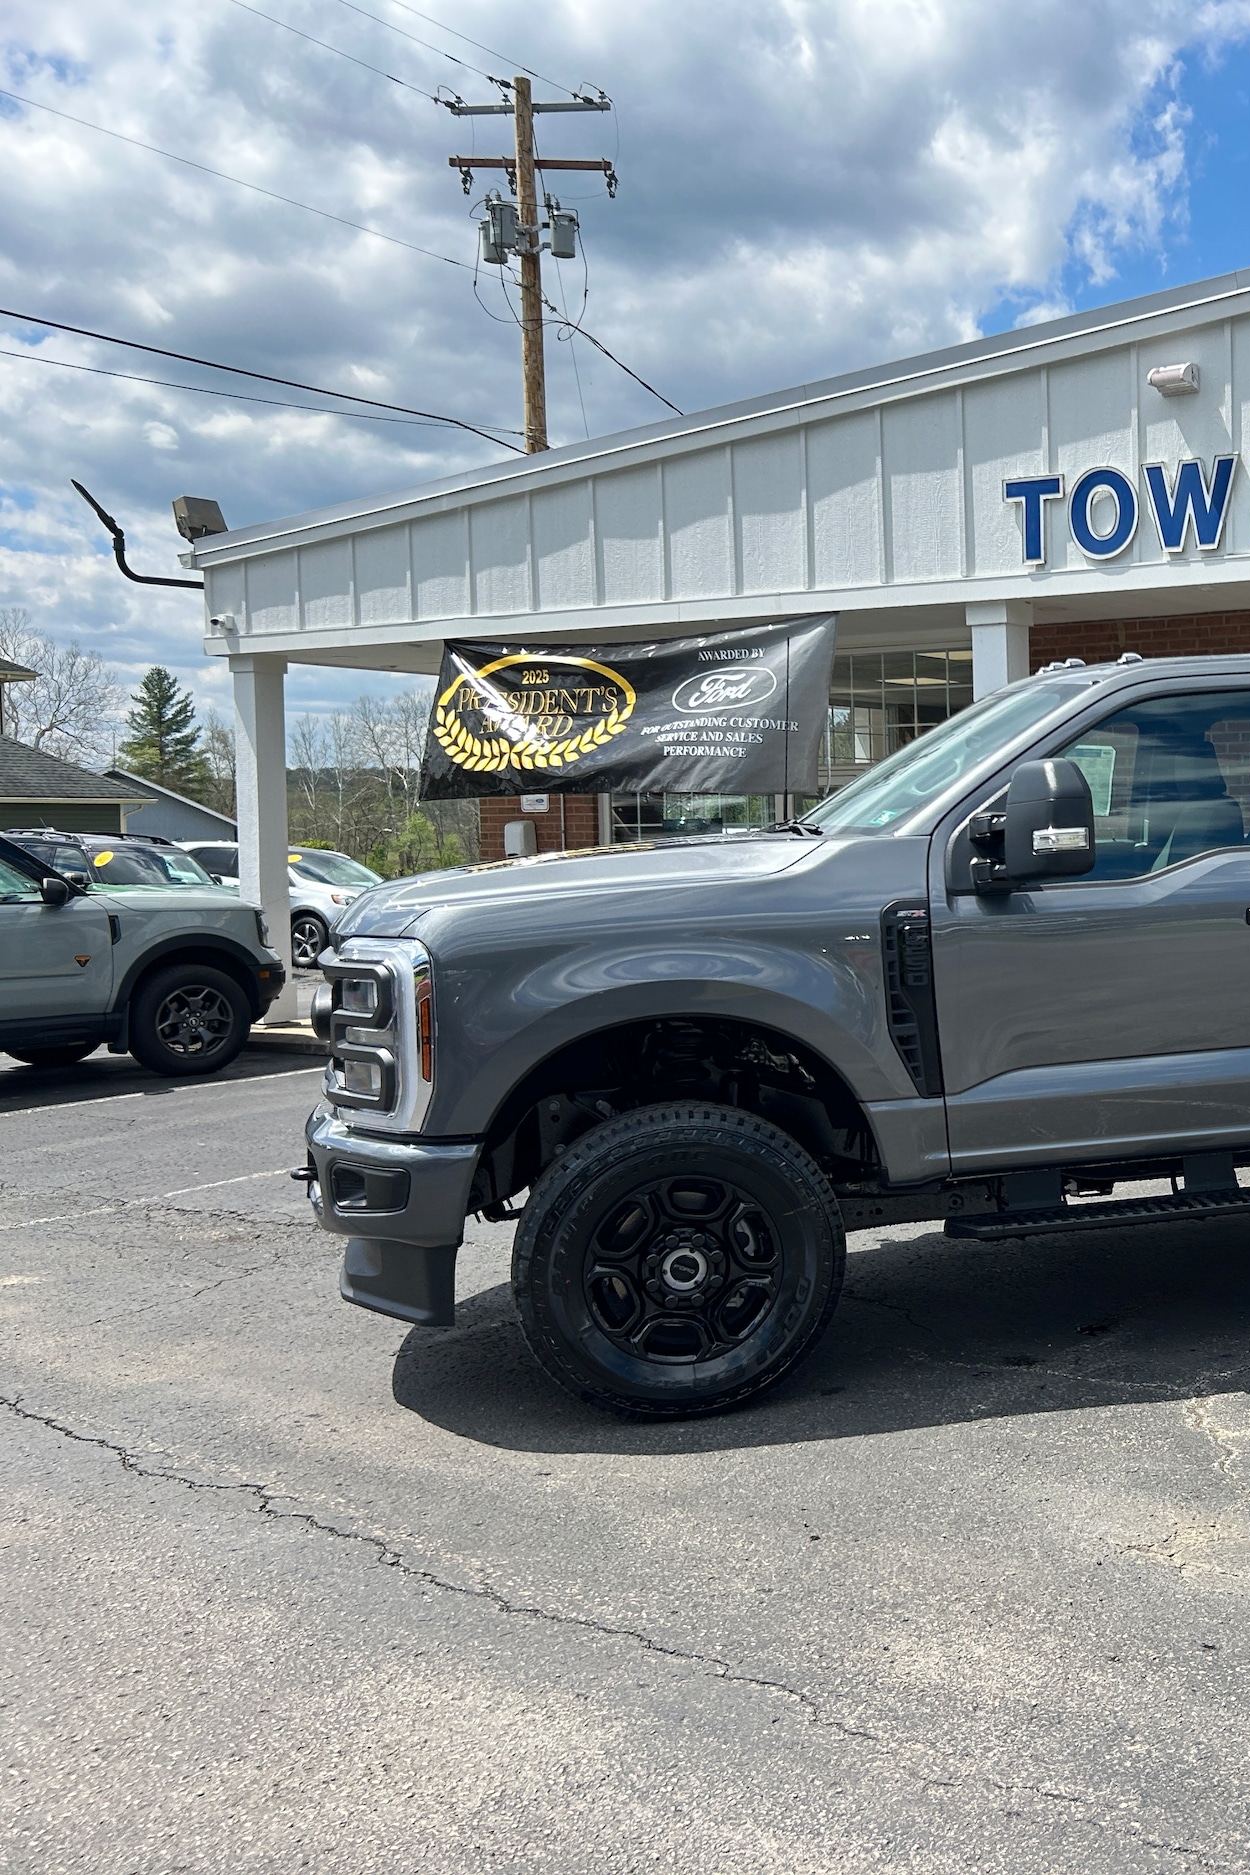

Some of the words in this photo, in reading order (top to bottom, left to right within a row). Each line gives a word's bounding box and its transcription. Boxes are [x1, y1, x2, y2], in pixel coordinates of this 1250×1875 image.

[697, 648, 750, 662] AWARDED
[751, 647, 766, 659] BY
[521, 669, 550, 685] 2025
[688, 672, 754, 708] Ford
[479, 715, 574, 738] ARD
[640, 725, 660, 736] FOR
[660, 716, 728, 732] OUTSTANDING
[729, 717, 800, 733] CUSTOMER
[655, 731, 698, 743] SERVICE
[699, 731, 724, 743] AND
[725, 732, 764, 745] SALES
[663, 745, 747, 758] PERFORMANCE
